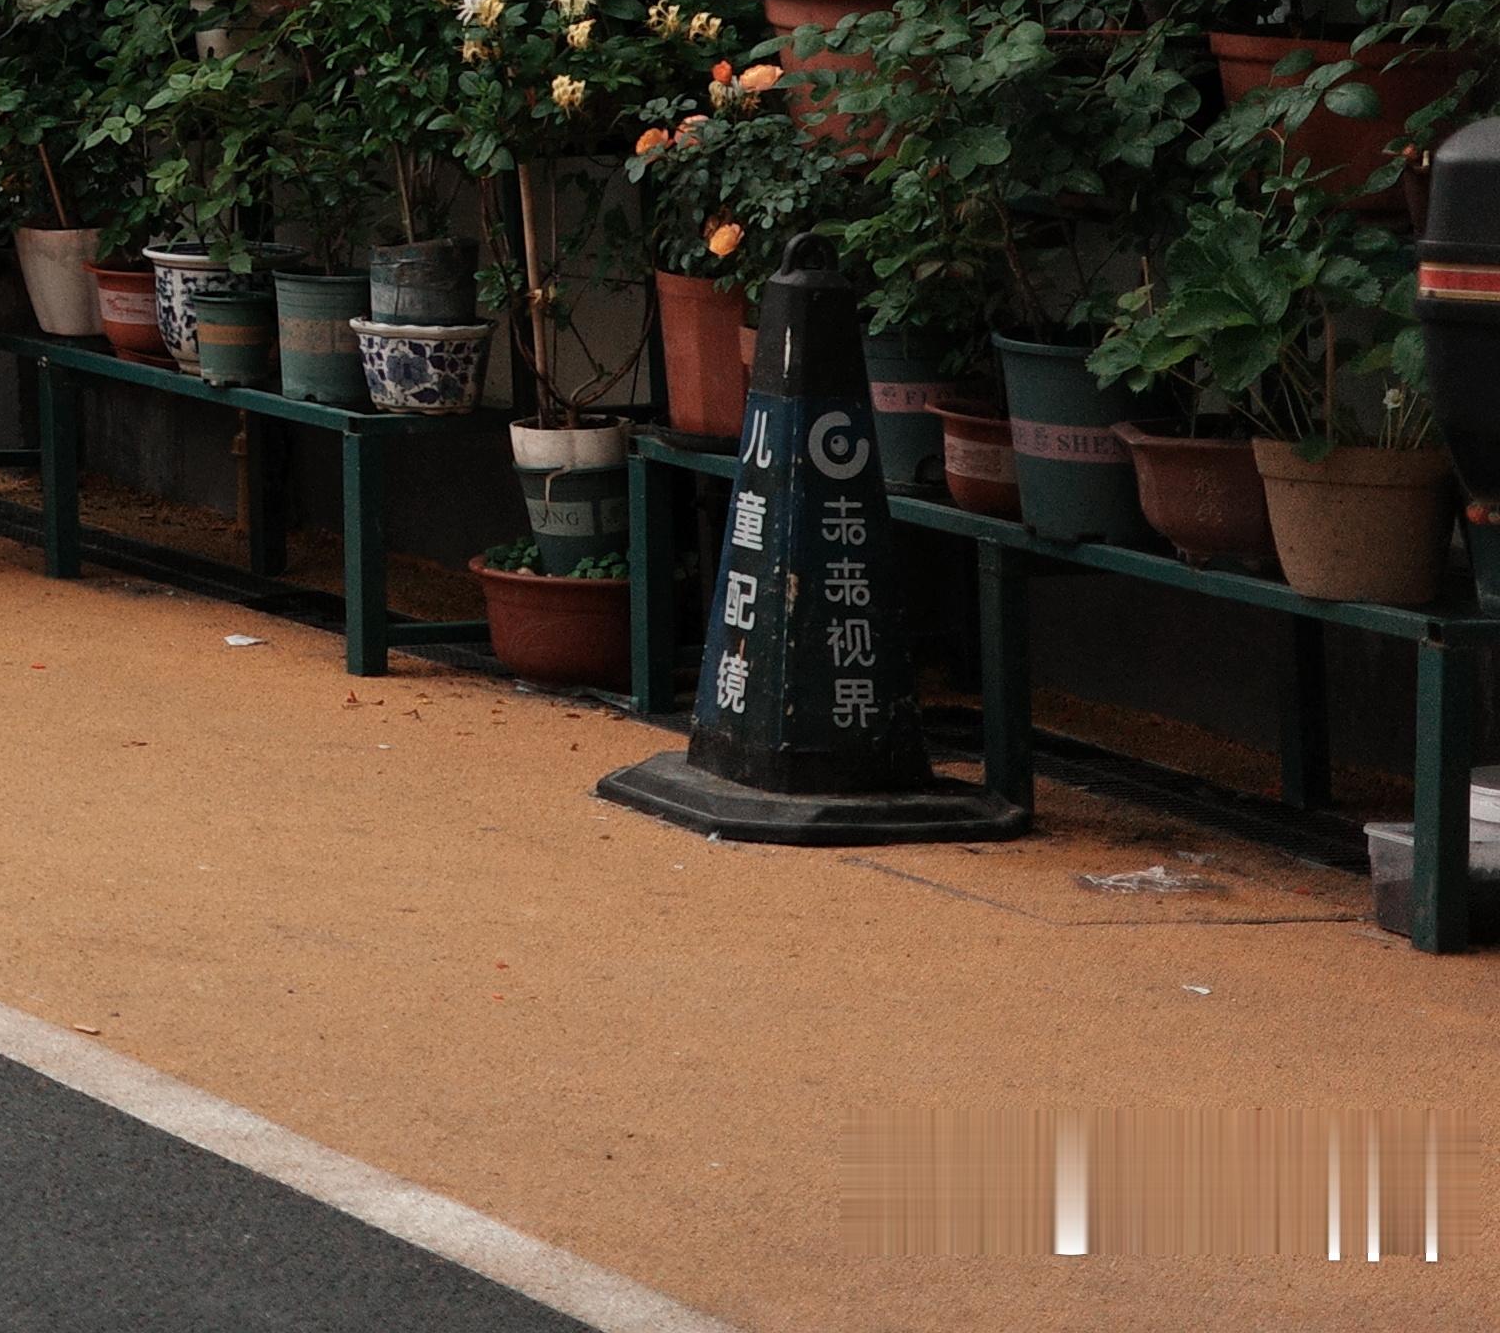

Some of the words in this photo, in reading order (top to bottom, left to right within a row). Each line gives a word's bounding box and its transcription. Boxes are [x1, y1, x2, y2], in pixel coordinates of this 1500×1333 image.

[716, 409, 772, 714] 儿童配镜
[821, 495, 880, 729] 未来视界
